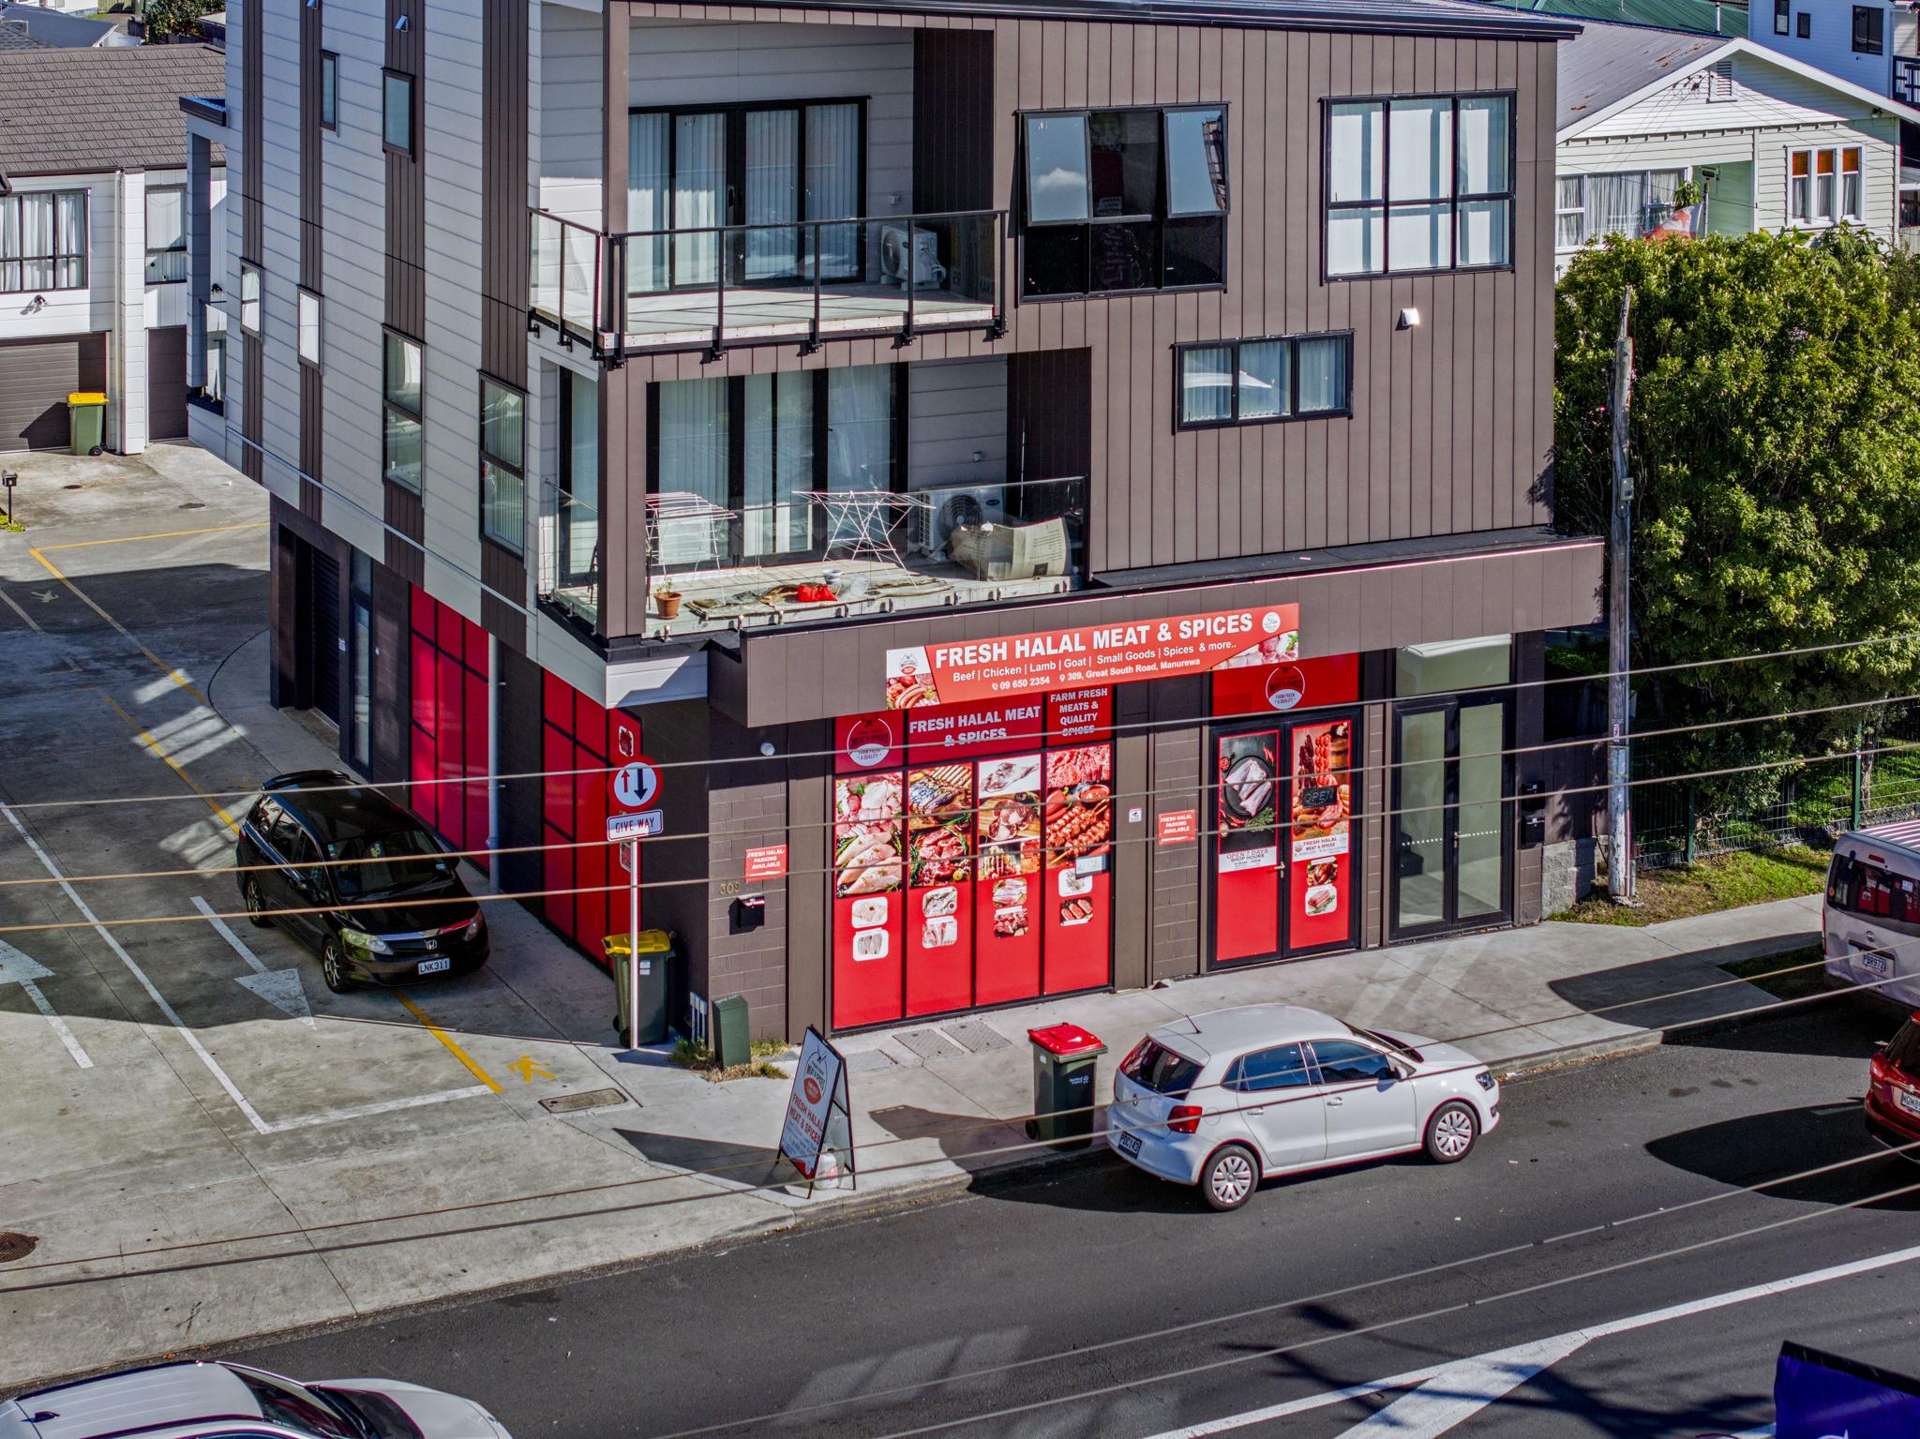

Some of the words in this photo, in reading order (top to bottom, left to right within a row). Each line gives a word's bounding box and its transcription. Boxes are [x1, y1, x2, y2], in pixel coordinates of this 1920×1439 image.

[935, 641, 1008, 669] FRESH
[1015, 633, 1086, 659] HALAL
[1093, 625, 1151, 650] MEAT
[1157, 622, 1172, 642] &
[1179, 613, 1253, 640] SPICES
[953, 670, 976, 683] Beef
[983, 666, 1022, 679] Chicken
[1030, 660, 1057, 673] Lamb
[1064, 656, 1087, 668] Goat
[1096, 652, 1123, 665] Small
[1125, 648, 1156, 661] Goods
[1163, 645, 1194, 659] Spices
[1199, 643, 1206, 652] &
[999, 681, 1011, 690] 09
[1085, 668, 1108, 679] Great
[1109, 665, 1134, 676] South
[1160, 658, 1201, 670] Manurewa
[1050, 691, 1076, 703] FARM
[1078, 688, 1108, 699] FRESH
[1059, 702, 1090, 713] MEATS
[1091, 700, 1099, 709] &
[909, 717, 954, 734] FRESH
[958, 711, 1001, 728] HALAL
[1005, 705, 1041, 721] MEAT
[1060, 712, 1099, 725] QUALITY
[944, 735, 954, 747] &
[958, 727, 1007, 744] SPICES
[1061, 725, 1096, 737] SPICES
[615, 820, 633, 833] GIVE
[638, 816, 655, 829] WAY
[420, 959, 449, 973] LNK311
